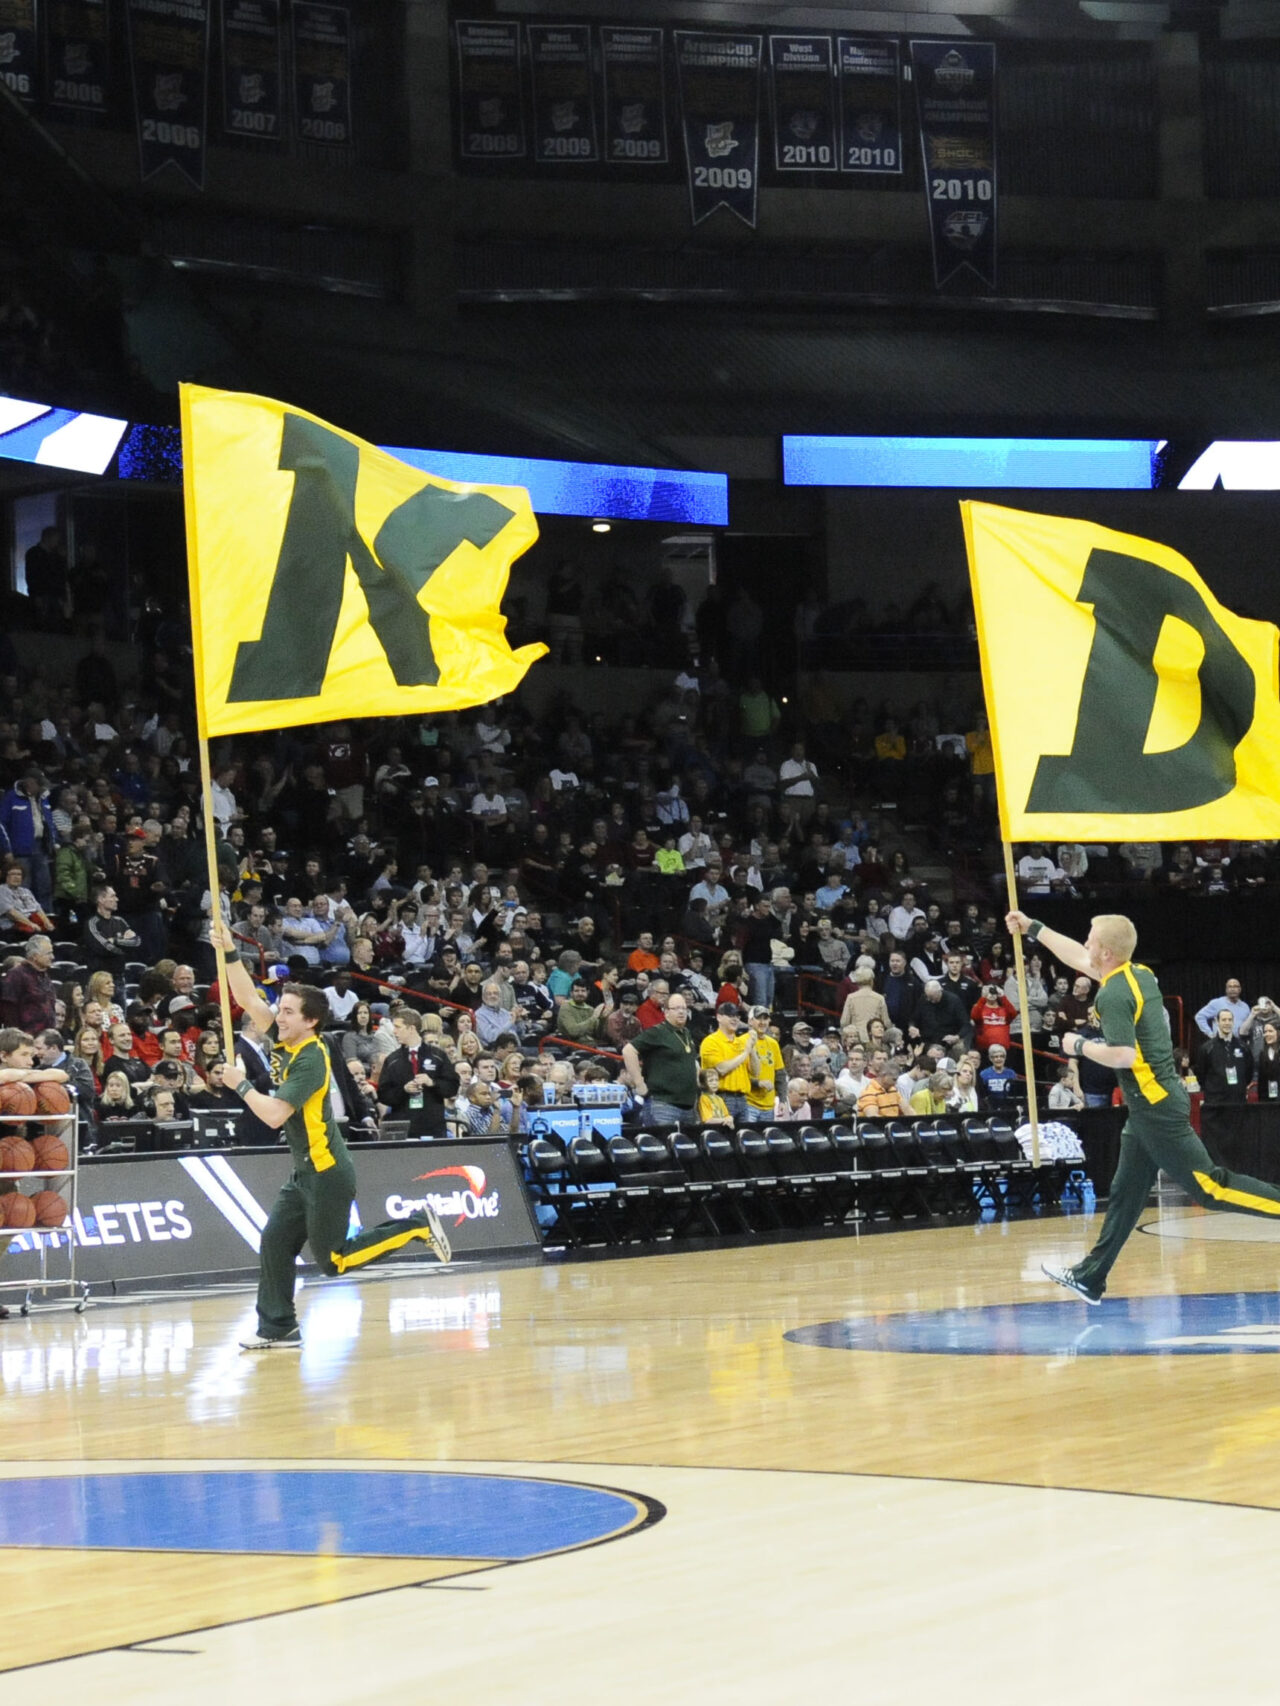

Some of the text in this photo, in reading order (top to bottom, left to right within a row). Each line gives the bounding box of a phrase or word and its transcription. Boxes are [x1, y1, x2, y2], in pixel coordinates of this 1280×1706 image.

[231, 109, 277, 133] 2007
[302, 118, 347, 141] 2008
[142, 119, 200, 149] 2006
[543, 137, 591, 156] 2009
[613, 139, 661, 157] 2009
[783, 145, 831, 164] 2010
[849, 148, 896, 166] 2010
[694, 166, 752, 189] 2009
[932, 179, 992, 200] 2010
[1024, 547, 1256, 814] D
